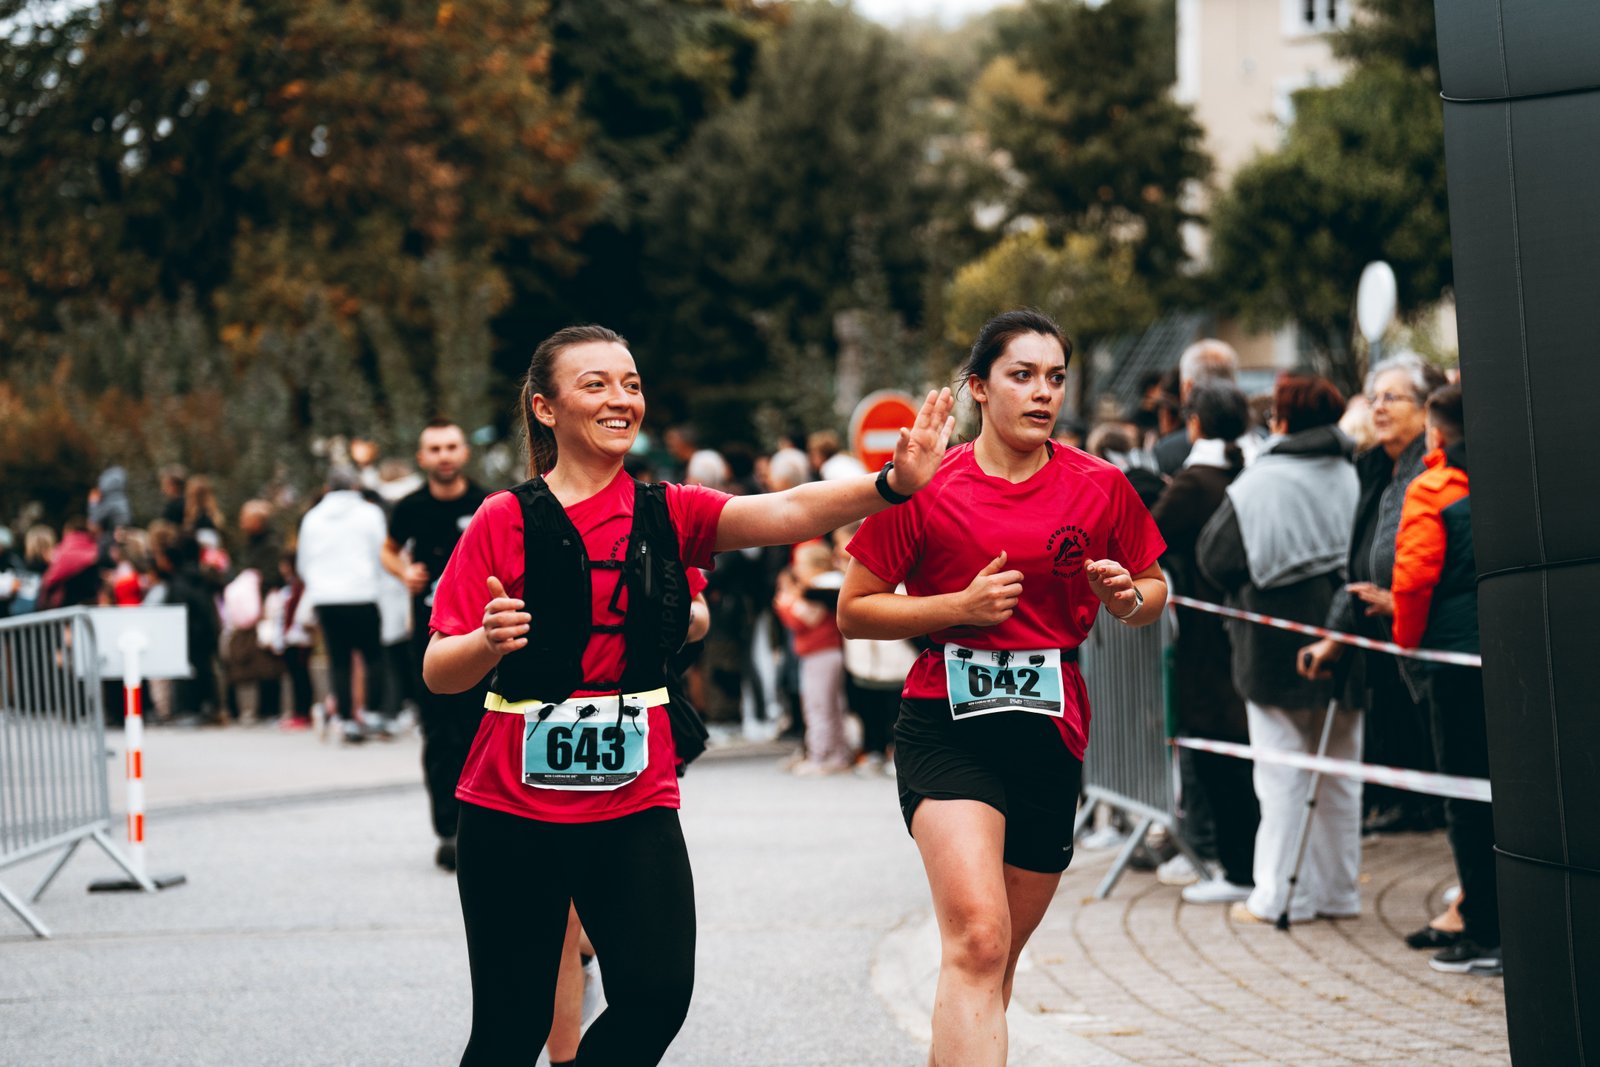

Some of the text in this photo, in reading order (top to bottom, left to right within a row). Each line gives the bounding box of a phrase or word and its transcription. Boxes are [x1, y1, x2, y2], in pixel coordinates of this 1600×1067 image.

[1046, 525, 1077, 551] OCTOBRE
[660, 558, 680, 648] KIPRUN
[968, 665, 1041, 698] 642
[546, 726, 626, 771] 643
